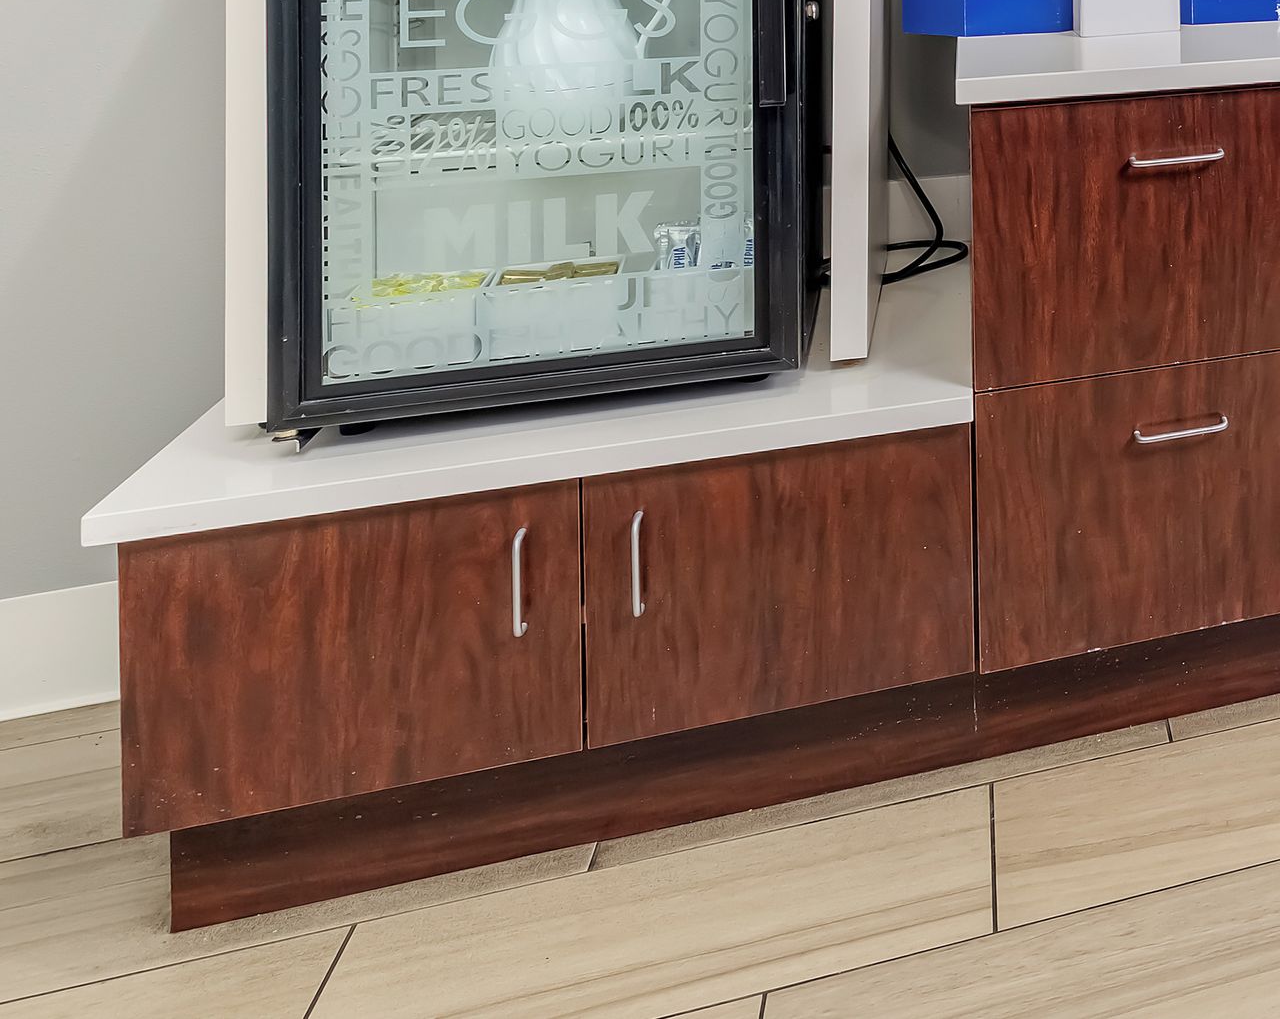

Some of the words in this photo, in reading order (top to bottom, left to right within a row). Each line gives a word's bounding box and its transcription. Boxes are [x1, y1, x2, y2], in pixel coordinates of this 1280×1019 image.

[370, 72, 512, 110] FRES
[412, 115, 493, 170] 2%
[502, 105, 613, 140] GOOD
[618, 98, 700, 133] 100%
[504, 133, 696, 173] YOGURT
[703, 144, 738, 220] GOOD
[422, 190, 657, 271] MILK
